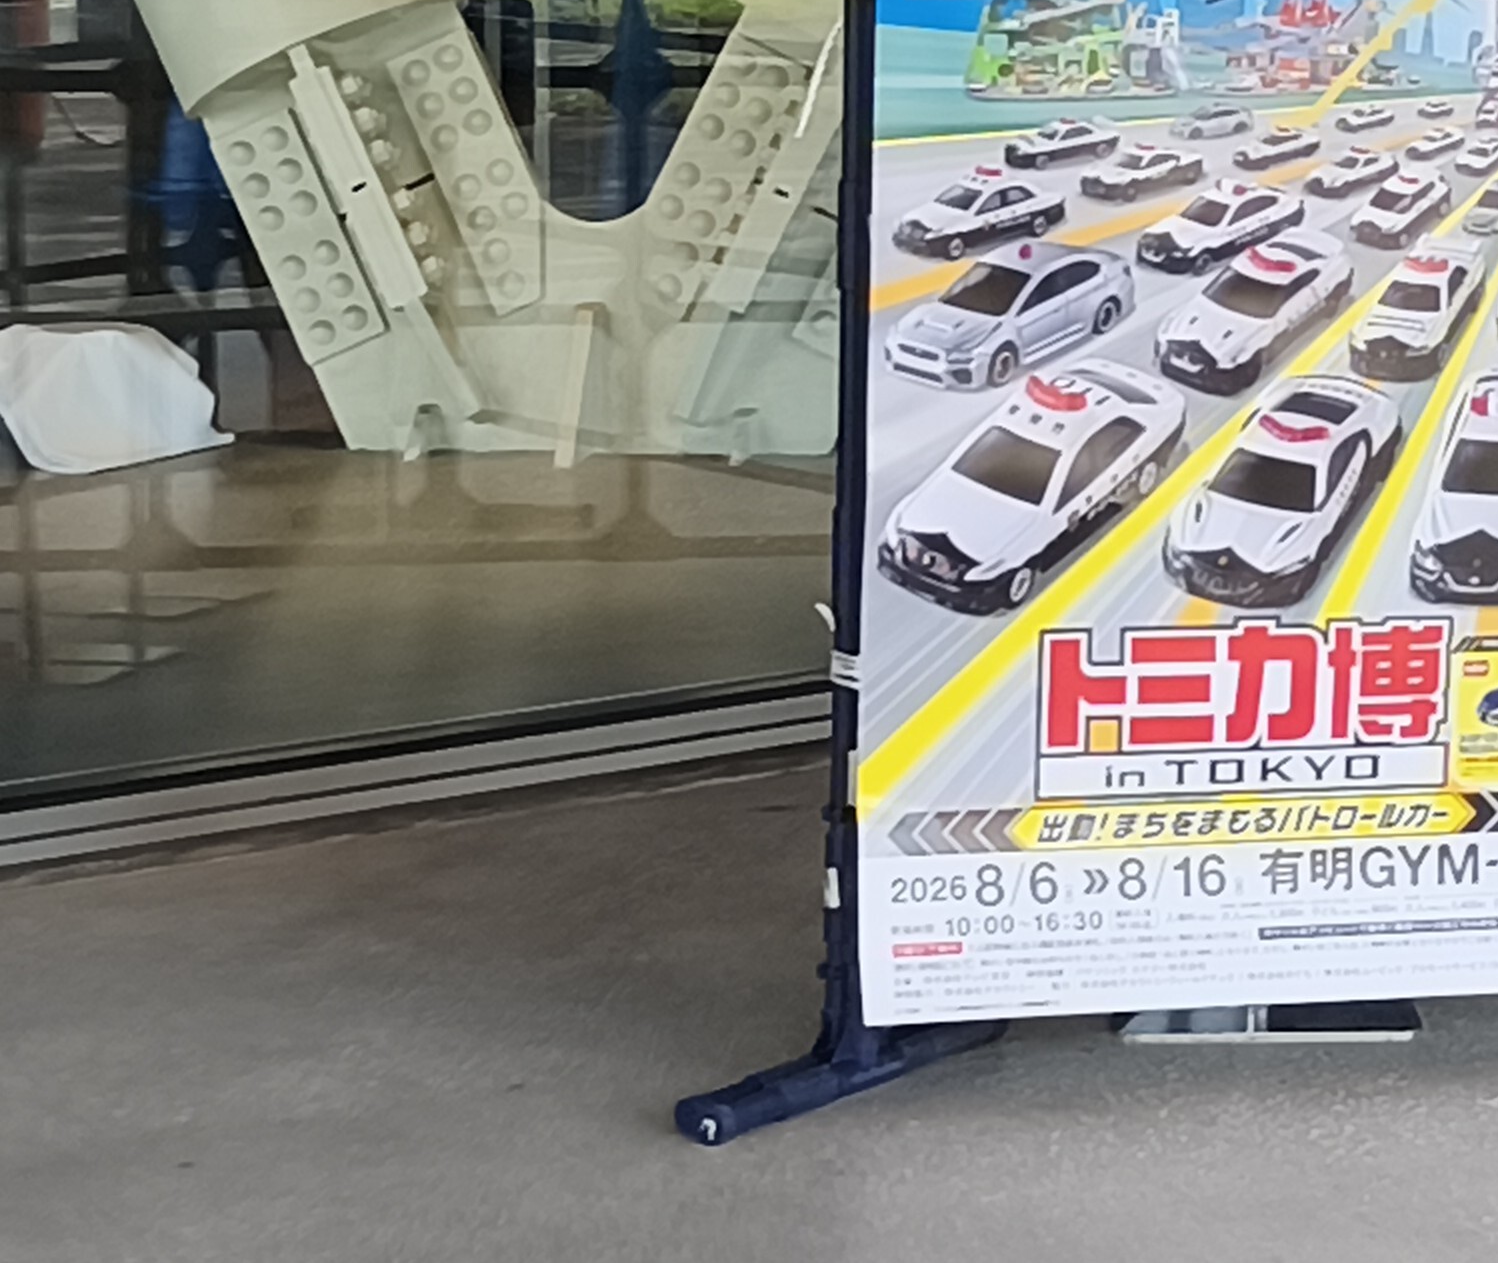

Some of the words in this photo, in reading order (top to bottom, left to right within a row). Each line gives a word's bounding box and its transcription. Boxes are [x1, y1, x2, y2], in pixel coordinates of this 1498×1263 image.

[1046, 624, 1444, 748] トミカ博
[1104, 766, 1145, 787] in
[1165, 754, 1380, 785] TOKYO
[891, 875, 968, 904] 2026
[974, 860, 1059, 907] 8/6
[1118, 853, 1226, 901] 8/16
